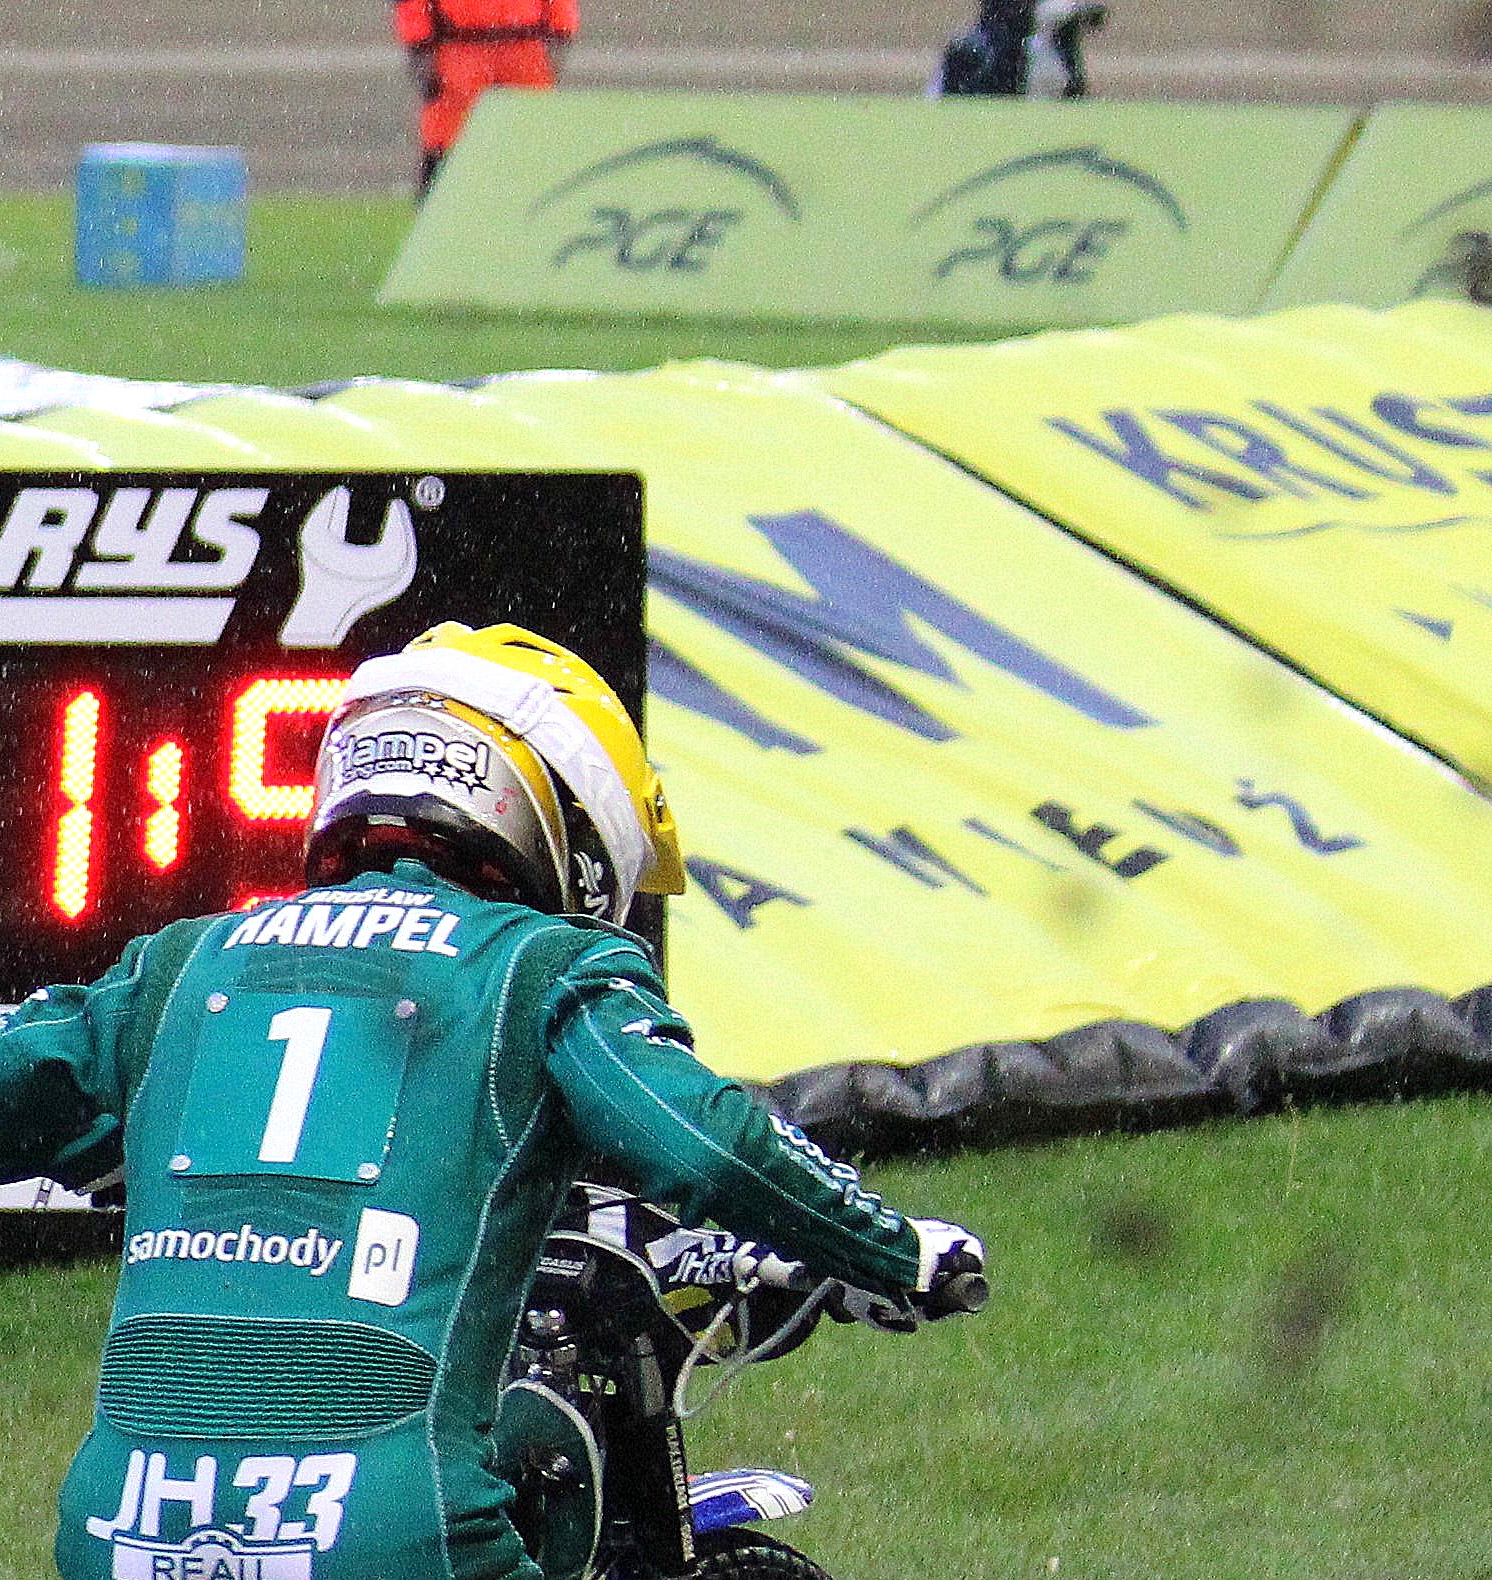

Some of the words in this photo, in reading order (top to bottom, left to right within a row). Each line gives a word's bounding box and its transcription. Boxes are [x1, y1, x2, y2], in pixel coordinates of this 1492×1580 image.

[553, 207, 743, 273] PGE
[938, 216, 1127, 286] PGE
[223, 904, 460, 957] HAMPEL
[257, 1007, 331, 1163] 1
[128, 1224, 342, 1276] samochody
